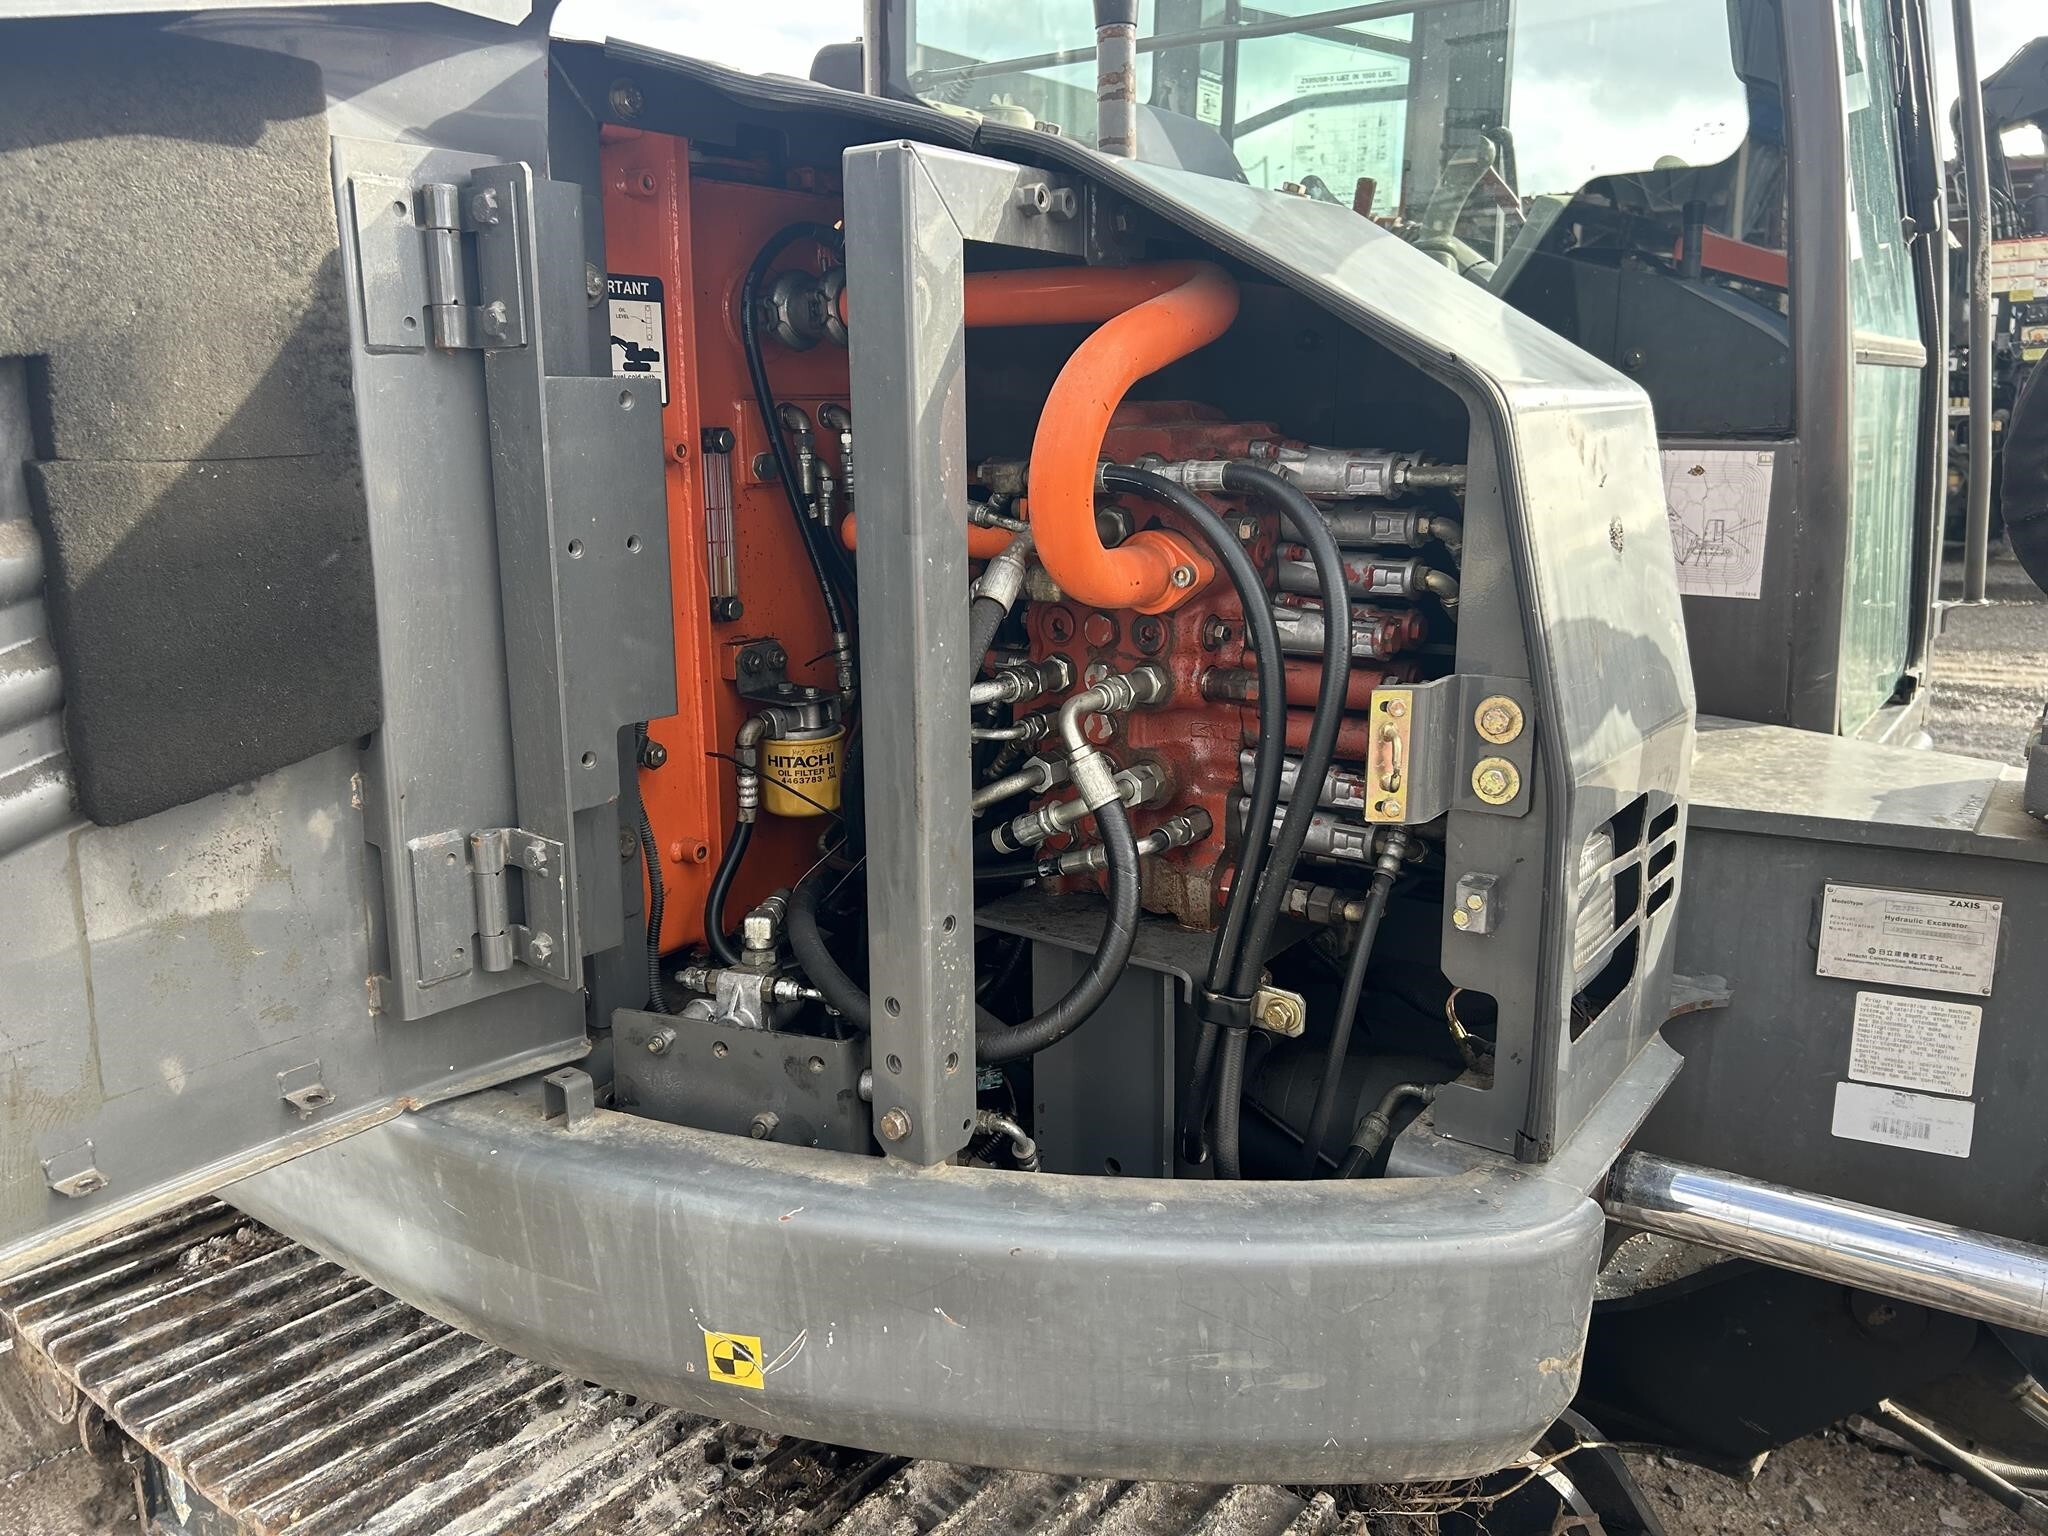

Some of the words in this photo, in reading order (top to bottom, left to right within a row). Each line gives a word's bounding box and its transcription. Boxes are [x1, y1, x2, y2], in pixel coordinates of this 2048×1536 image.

[607, 280, 649, 296] RTANT
[767, 752, 834, 768] HITACHI
[778, 769, 793, 777] OIL
[794, 768, 825, 777] FILTER
[781, 776, 823, 784] 4463783
[1948, 899, 1980, 909] ZAXIS
[1884, 914, 1922, 924] Hydraulic
[1926, 919, 1968, 928] Excavator
